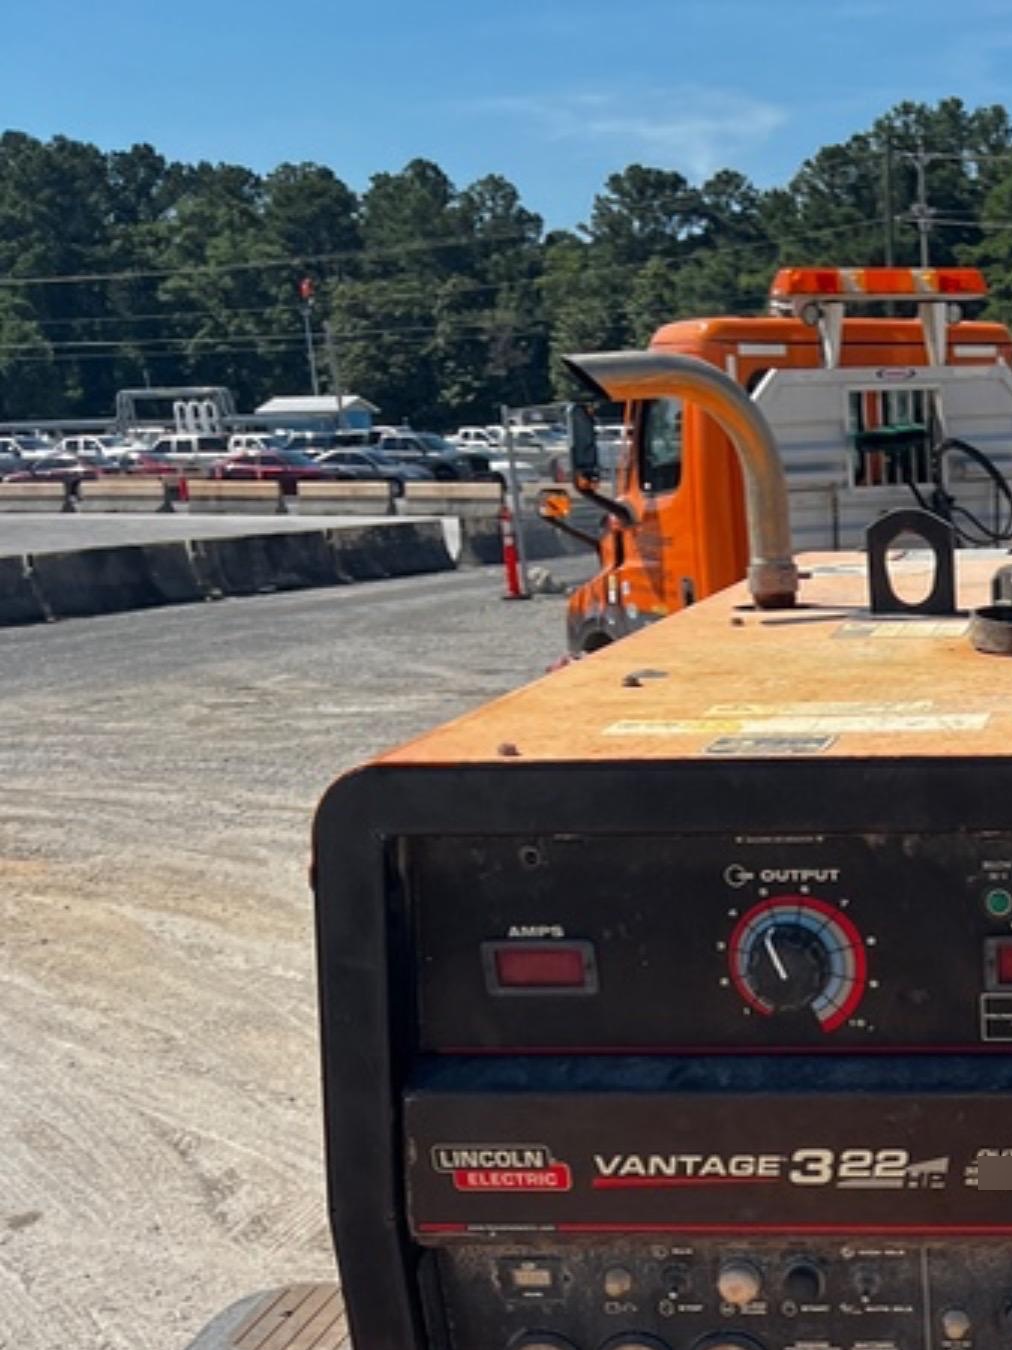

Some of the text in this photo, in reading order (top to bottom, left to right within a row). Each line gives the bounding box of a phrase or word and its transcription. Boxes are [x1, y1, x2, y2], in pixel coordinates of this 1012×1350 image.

[759, 868, 841, 883] OUTPUT
[508, 925, 565, 938] AMPS
[438, 1150, 546, 1169] LINCOLN
[593, 1154, 782, 1178] VANTAGE
[789, 1147, 909, 1185] 322
[466, 1171, 559, 1187] ELECTRIC
